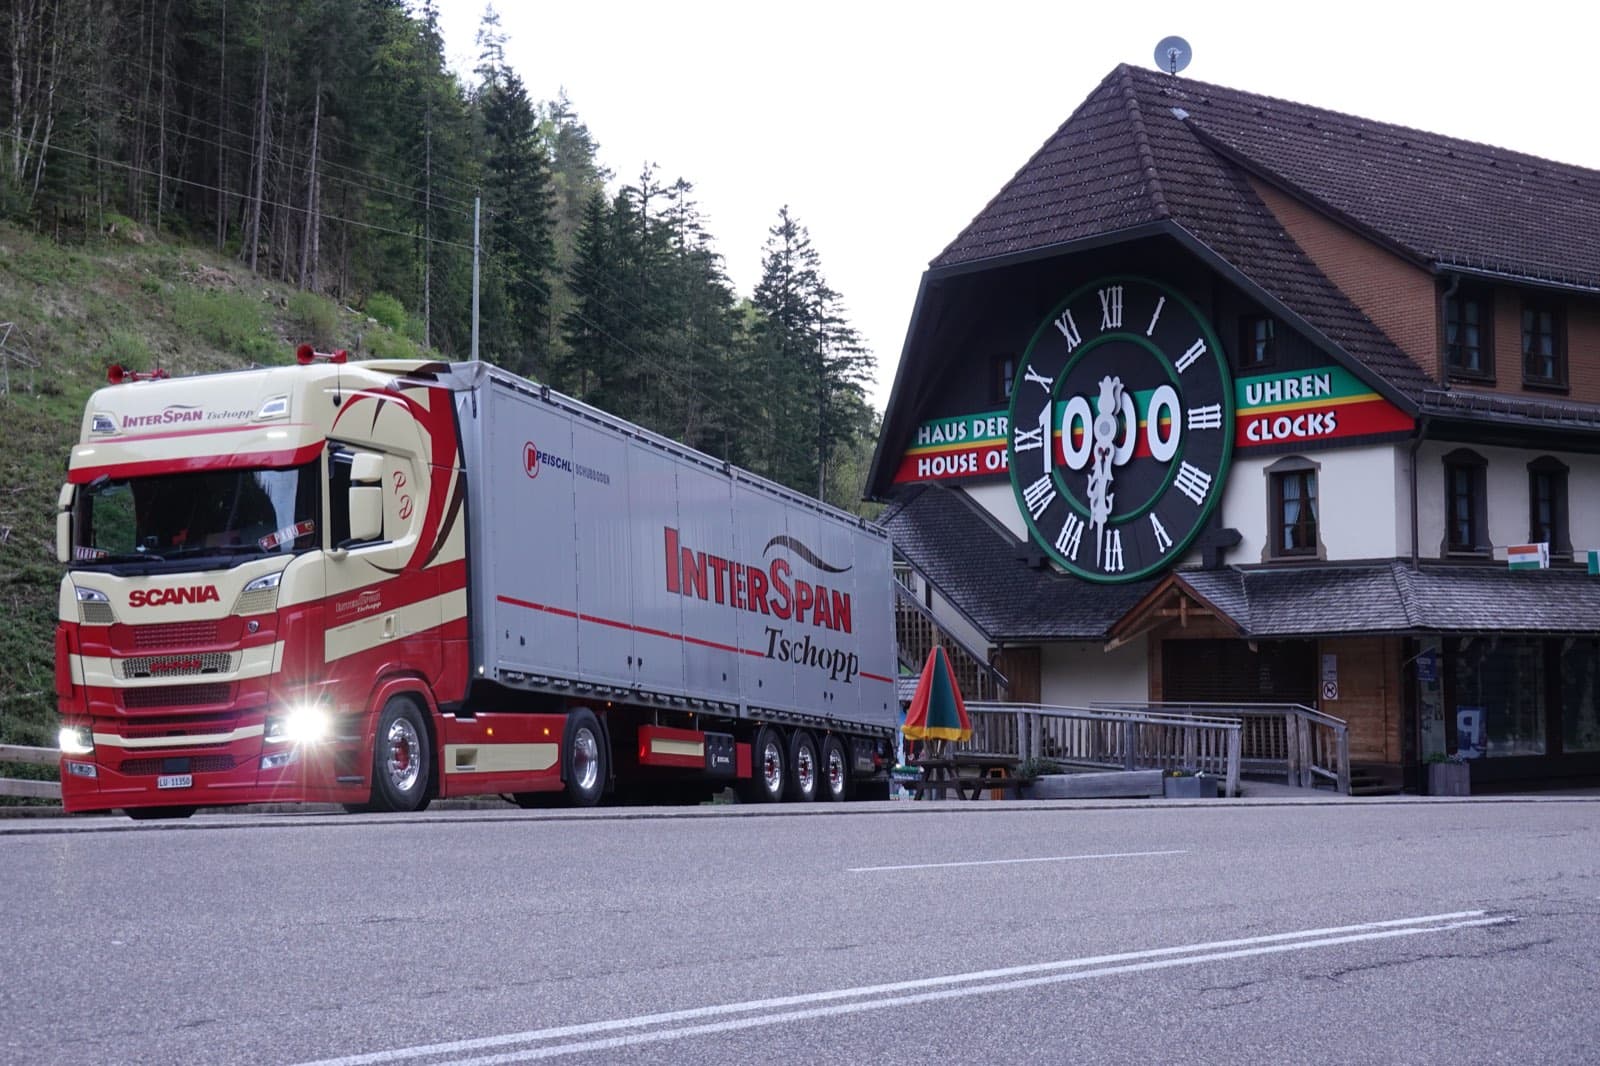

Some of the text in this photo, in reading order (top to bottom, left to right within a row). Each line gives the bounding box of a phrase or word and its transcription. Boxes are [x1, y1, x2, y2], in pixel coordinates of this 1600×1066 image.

[1098, 286, 1123, 331] XII
[1054, 309, 1082, 352] XI
[1175, 338, 1206, 373] II
[1024, 364, 1053, 394] X
[1246, 374, 1330, 405] UHREN
[207, 409, 255, 421] Tschopp
[1039, 385, 1181, 473] 1000
[1246, 411, 1336, 441] CLOCKS
[918, 417, 1008, 445] HAUS DER
[536, 450, 572, 472] PEISCHL
[918, 453, 978, 477] HOUSE
[1104, 529, 1124, 572] VI
[129, 585, 219, 608] SCANIA
[765, 625, 859, 684] Tschopp
